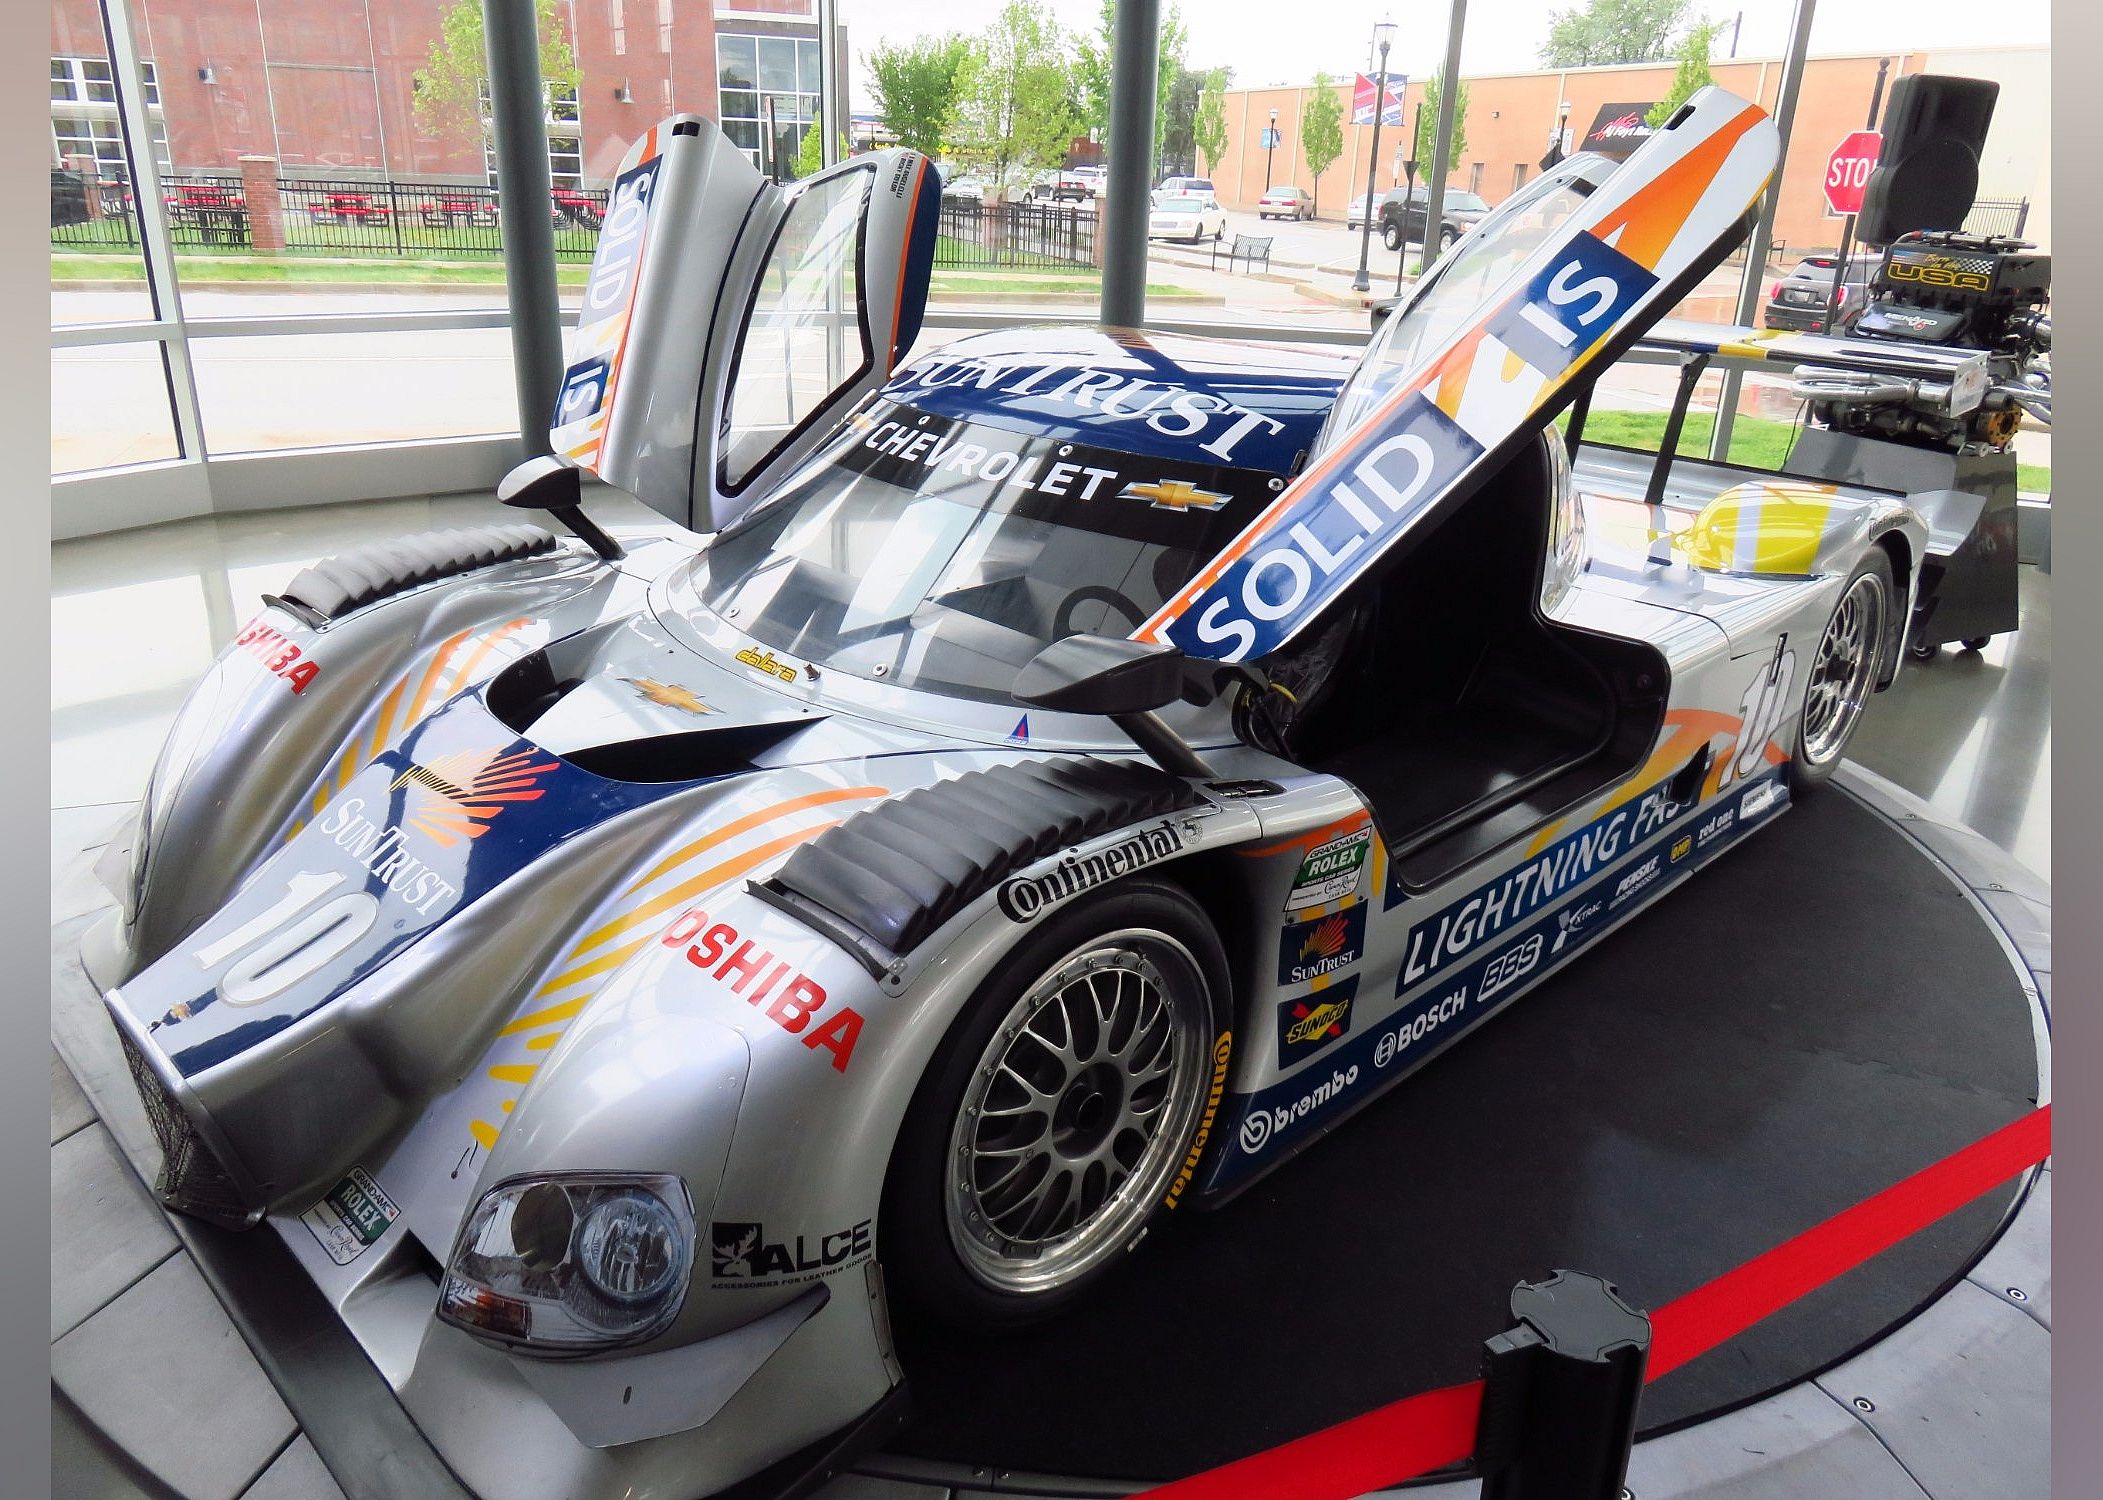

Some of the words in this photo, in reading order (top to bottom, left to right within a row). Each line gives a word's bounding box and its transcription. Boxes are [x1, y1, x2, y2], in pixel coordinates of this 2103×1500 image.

[1828, 157, 1878, 188] STO
[590, 171, 651, 310] SOLID
[1887, 262, 1990, 292] USA
[564, 365, 603, 414] IS
[880, 361, 1287, 463] SUNTRUST
[865, 420, 1119, 501] CHEVROLET
[1198, 433, 1435, 663] SOLID
[1518, 258, 1619, 348] IS
[735, 646, 798, 684] dallara
[1716, 648, 1796, 794] 10
[996, 818, 1185, 925] Continental
[1308, 846, 1359, 877] ROLEX
[1403, 812, 1628, 985] LIGHTNING
[192, 869, 380, 1009] 10
[661, 907, 865, 1074] OSHIBA
[1273, 1064, 1359, 1134] brembo
[1397, 985, 1467, 1053] BOSCH
[1477, 933, 1544, 1002] BBS
[1288, 1002, 1347, 1042] SUNOCO
[1164, 1030, 1233, 1210] Continental
[341, 1184, 381, 1232] ROLEX
[750, 1218, 872, 1277] ALCE
[803, 1266, 845, 1282] LEATHER
